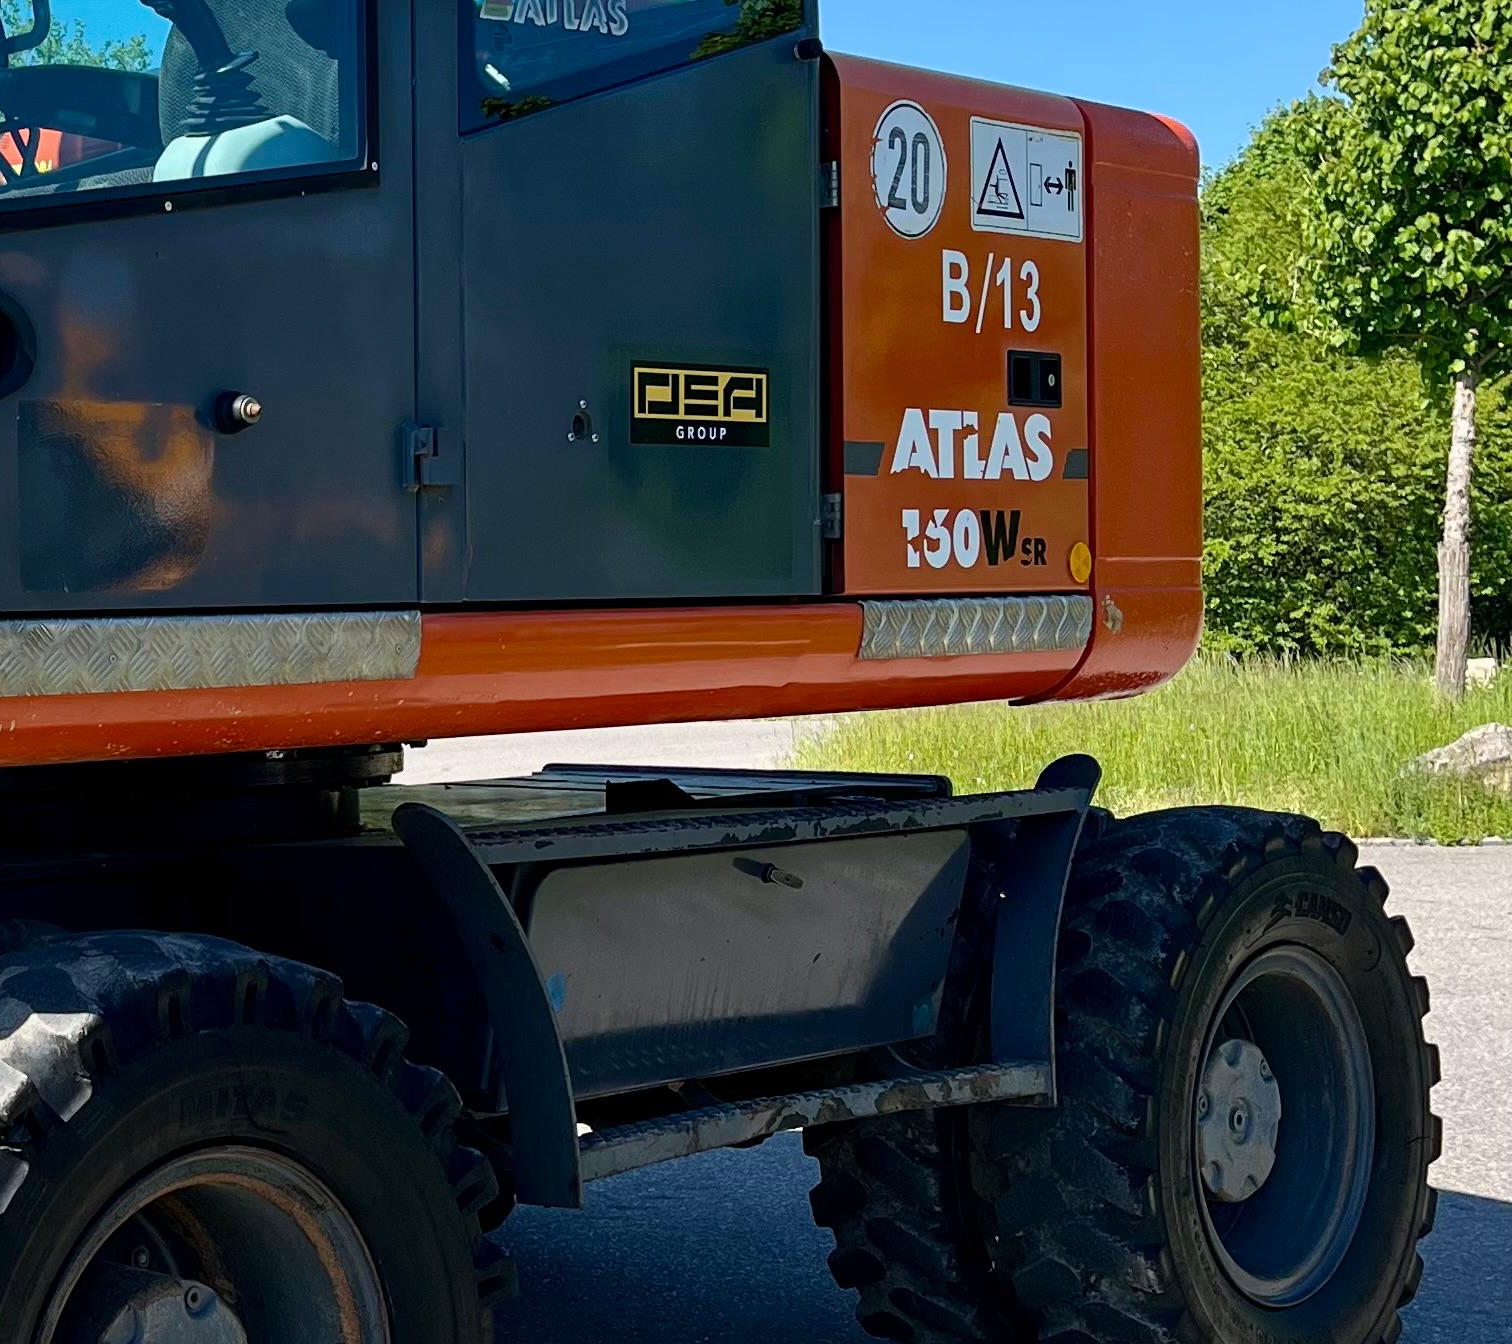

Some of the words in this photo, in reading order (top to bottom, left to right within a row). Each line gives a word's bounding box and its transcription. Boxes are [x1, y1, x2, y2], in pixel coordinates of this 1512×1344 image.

[887, 125, 931, 215] 20
[941, 248, 1042, 334] B/13
[674, 424, 728, 441] GROUP
[890, 407, 1055, 482] ATLAS
